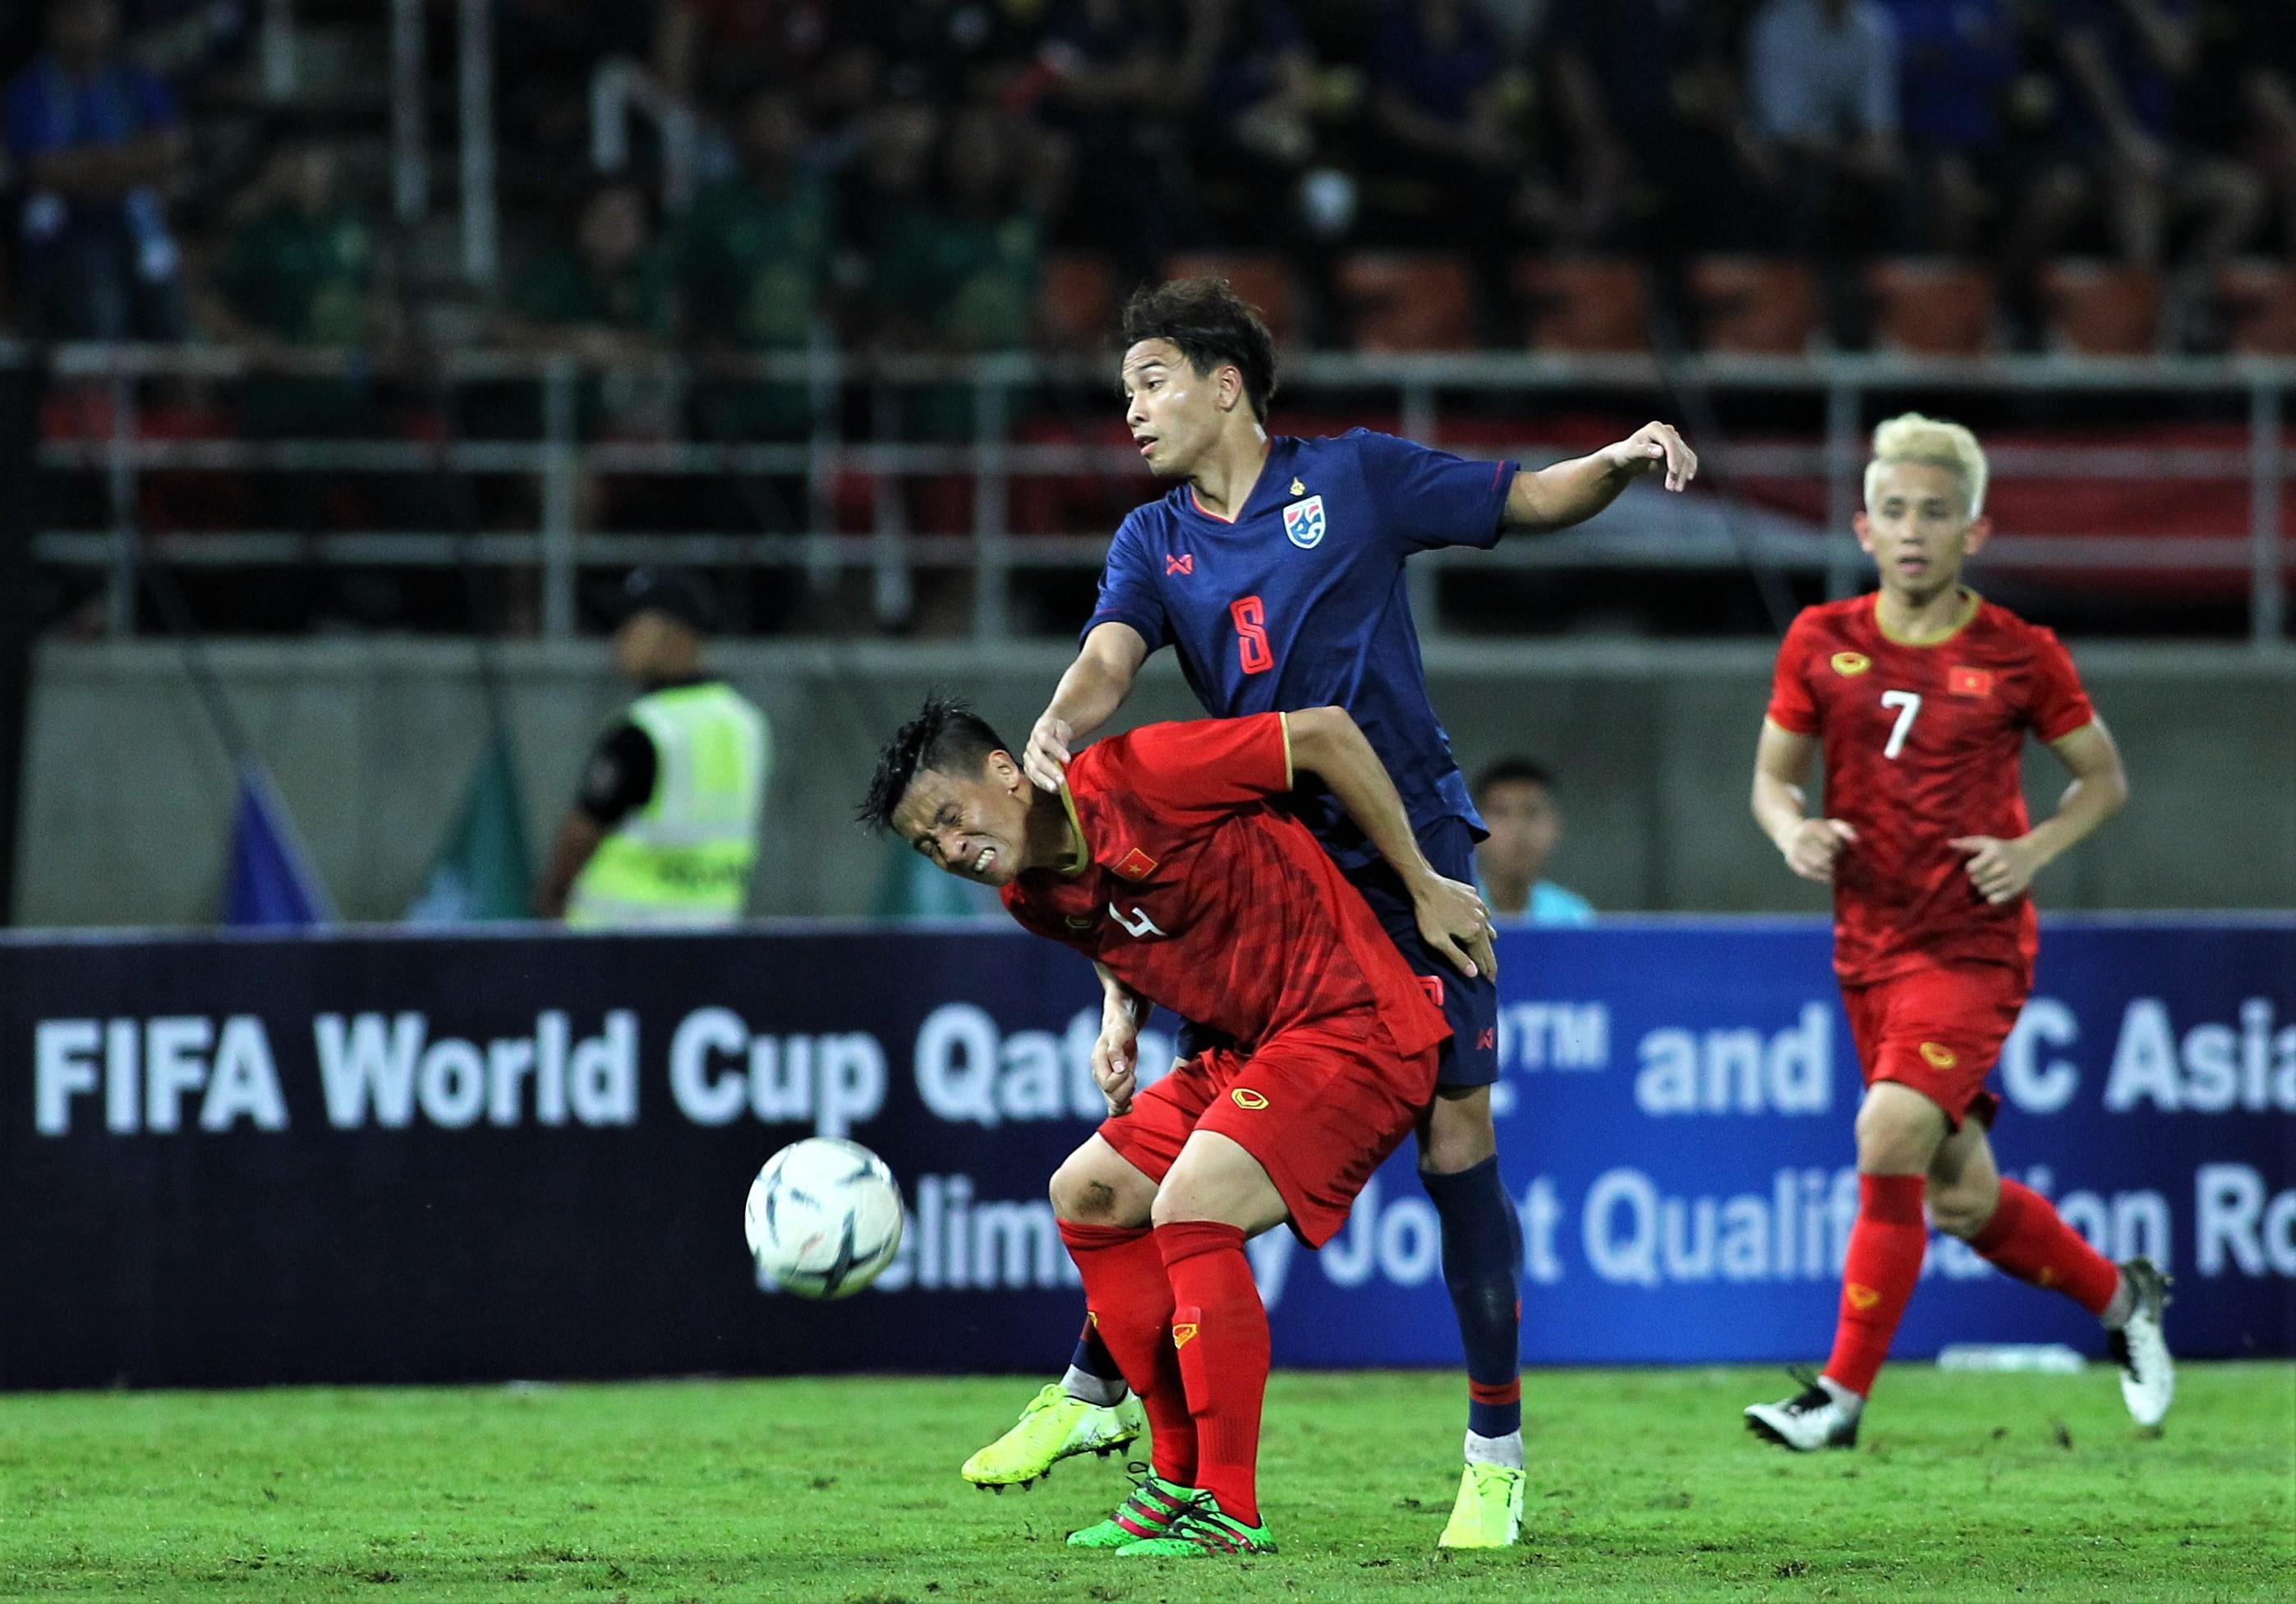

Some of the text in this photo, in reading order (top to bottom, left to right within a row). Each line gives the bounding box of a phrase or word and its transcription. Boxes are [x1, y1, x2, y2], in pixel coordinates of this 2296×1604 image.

[1230, 595, 1274, 674] 8
[1880, 690, 1921, 759] 7
[1109, 902, 1166, 937] 4
[35, 1015, 288, 1135] FIFA
[313, 1009, 638, 1128] World
[669, 1006, 887, 1138] Cup
[913, 1002, 1178, 1125] Qat
[1633, 1000, 1834, 1117] and
[1321, 1173, 1564, 1286] Jot
